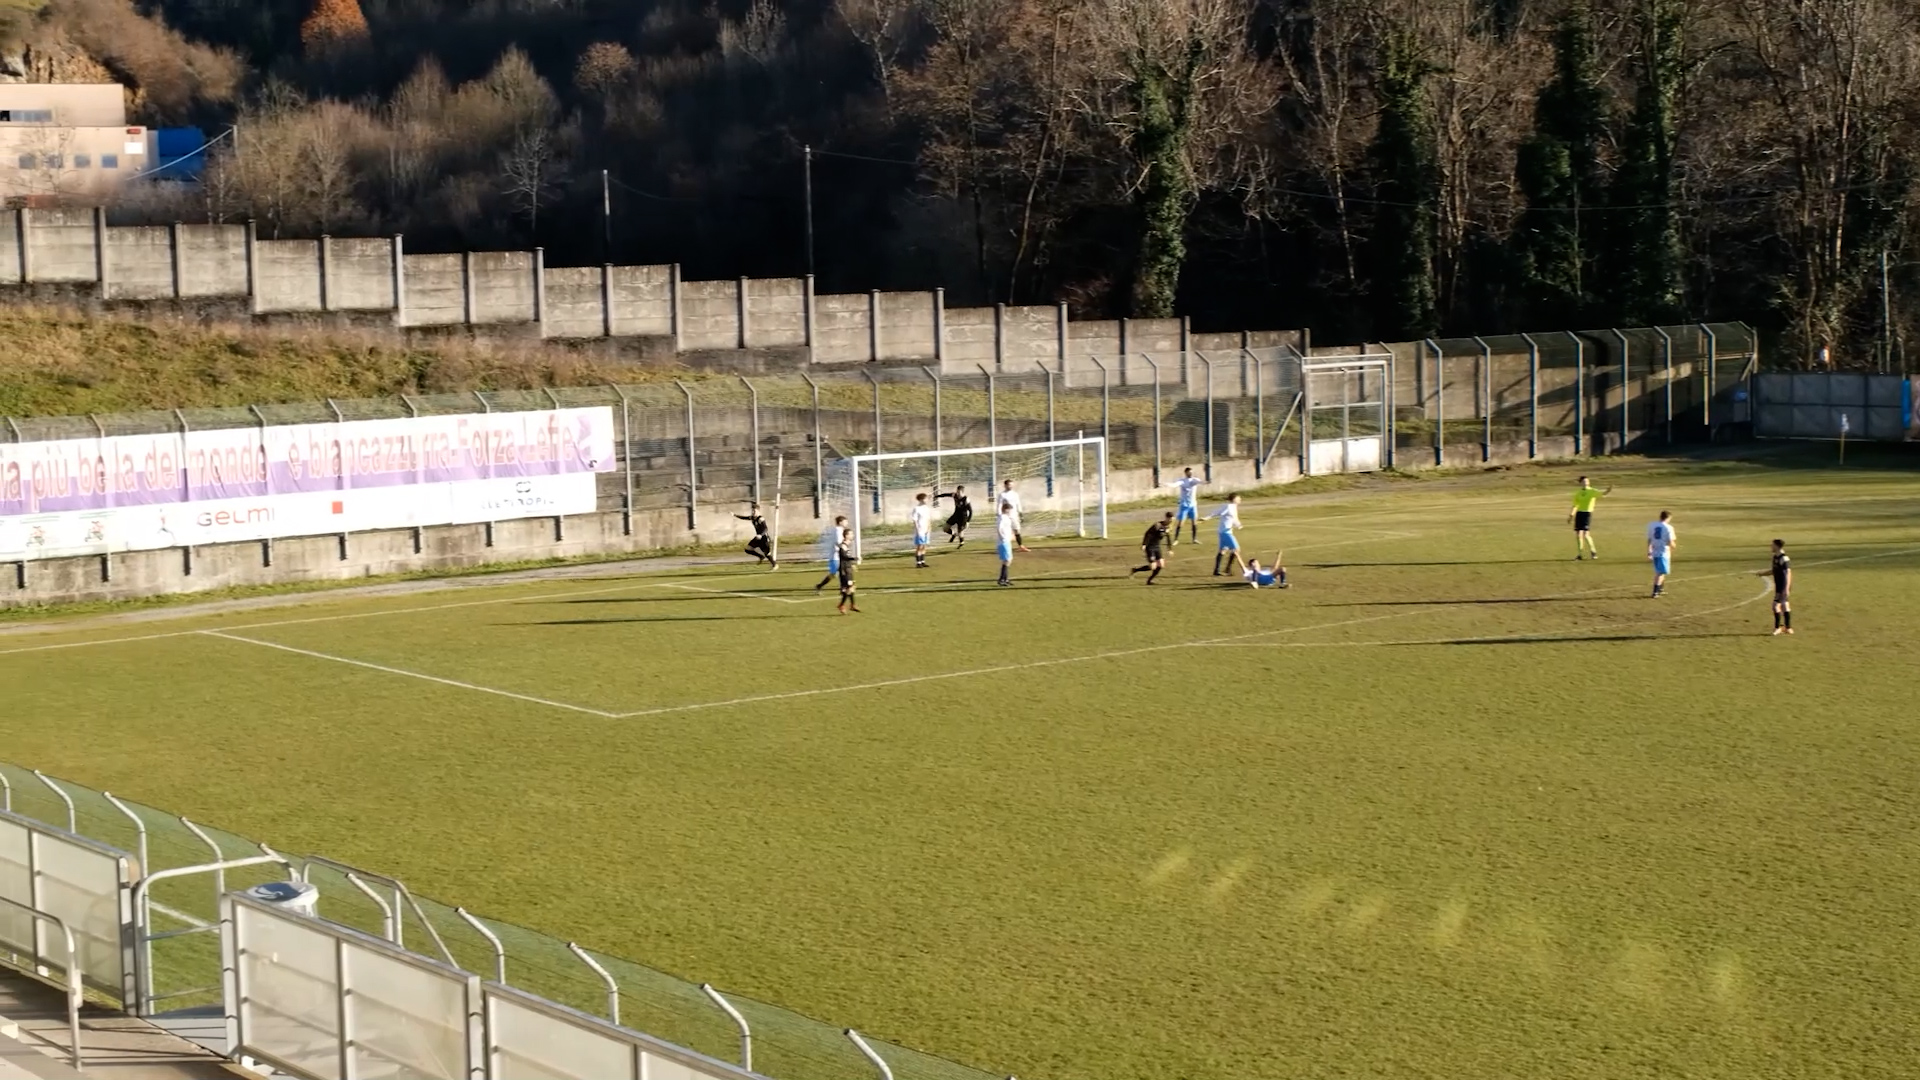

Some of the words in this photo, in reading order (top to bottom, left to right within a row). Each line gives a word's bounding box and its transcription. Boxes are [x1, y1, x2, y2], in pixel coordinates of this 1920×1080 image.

[31, 443, 70, 512] più
[76, 440, 137, 496] bela
[144, 437, 182, 490] del
